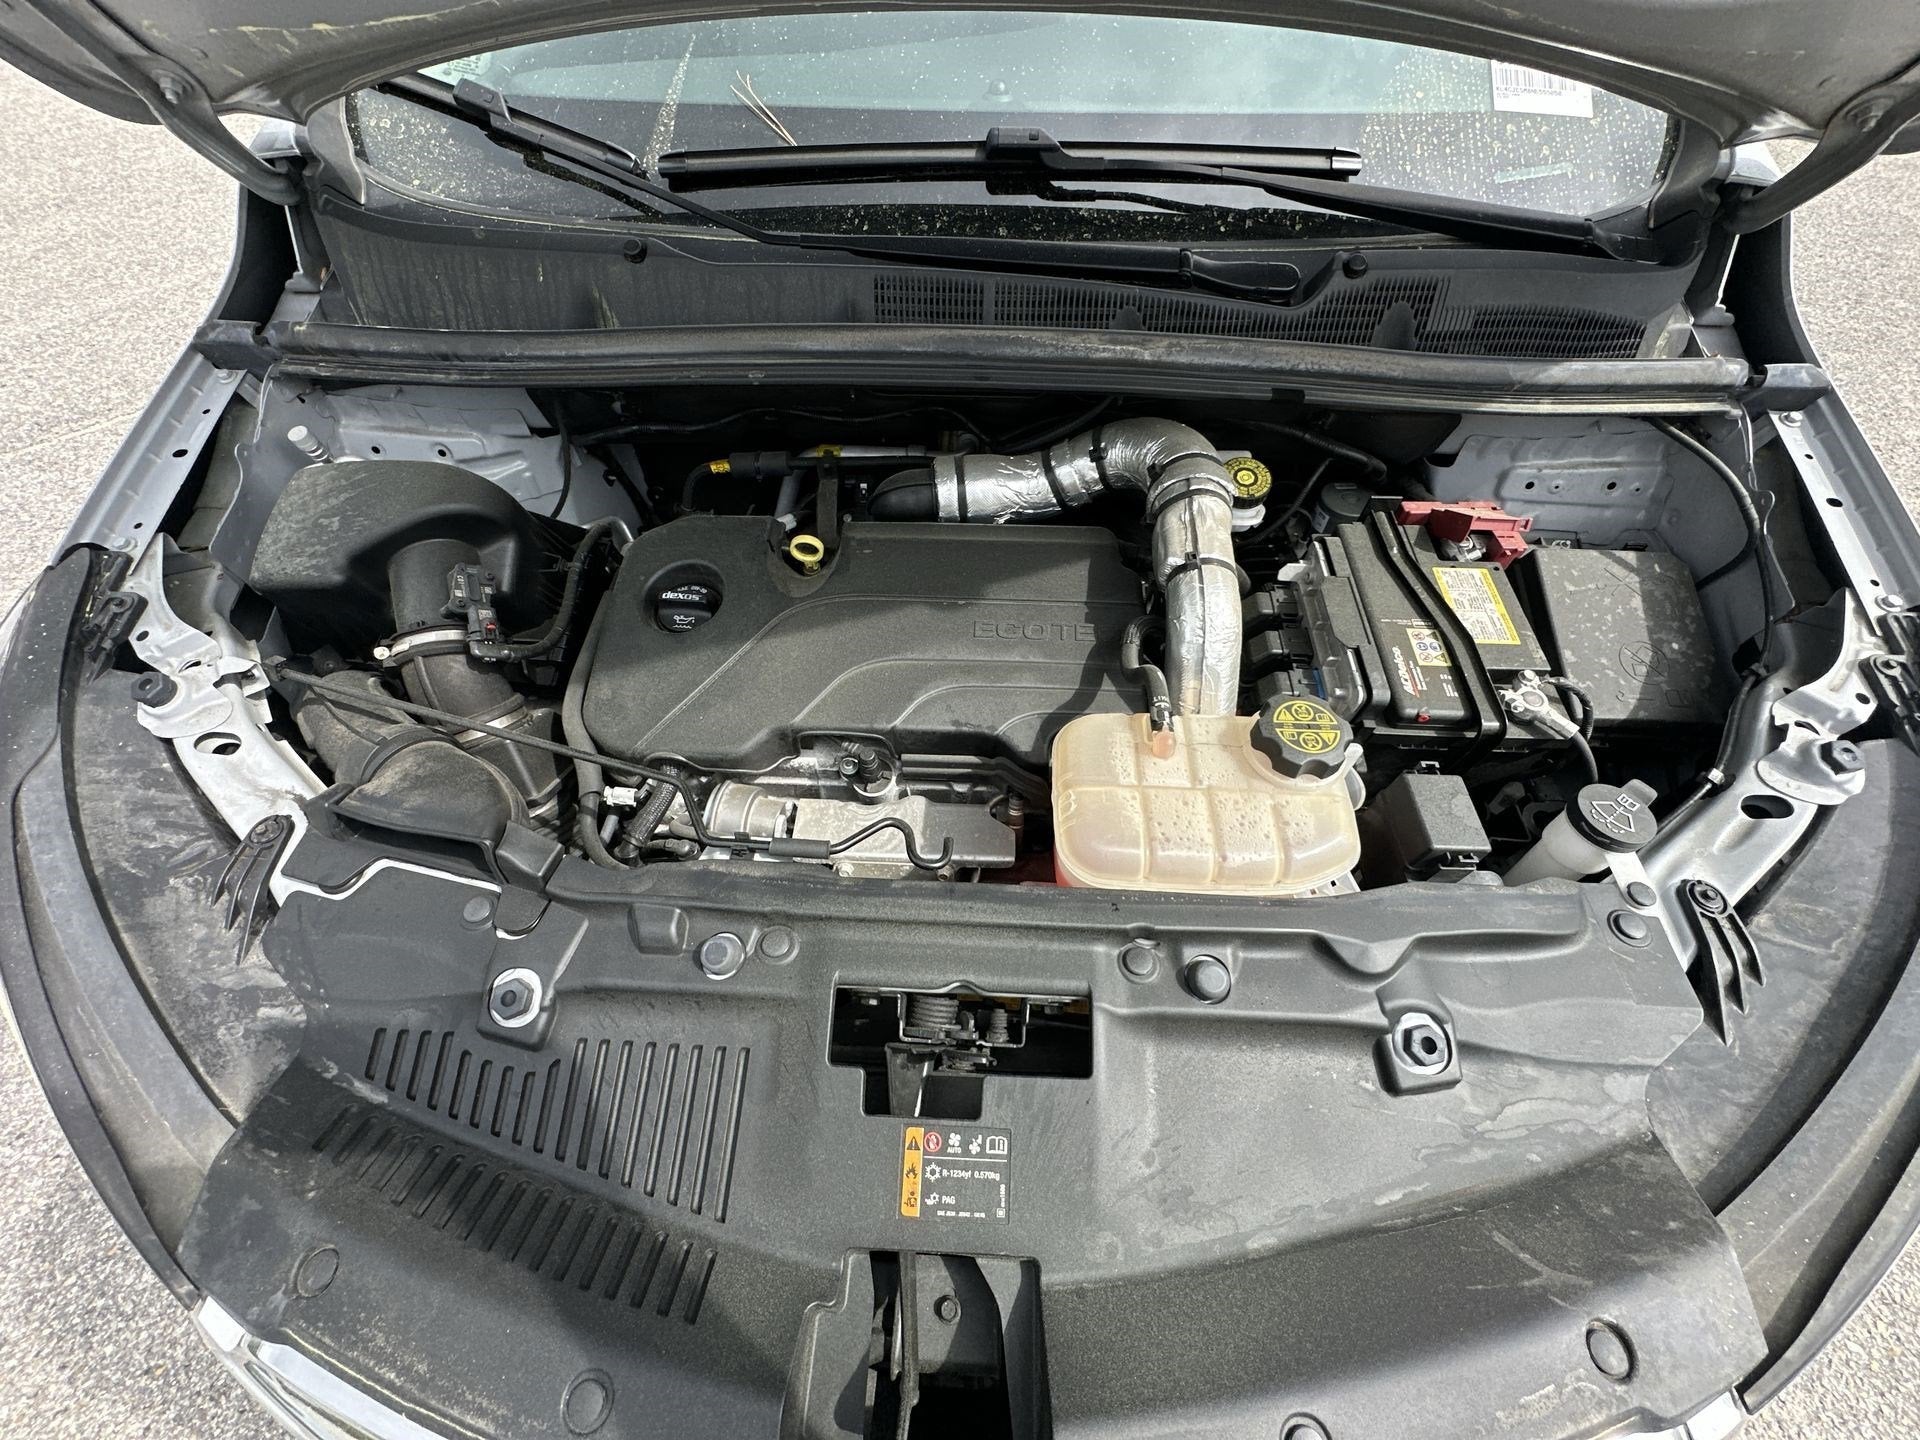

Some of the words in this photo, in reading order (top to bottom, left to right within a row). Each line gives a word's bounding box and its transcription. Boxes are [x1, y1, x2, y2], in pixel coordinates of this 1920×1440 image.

[661, 590, 701, 601] dexos
[972, 620, 1098, 642] ECOTE
[1391, 646, 1416, 696] ACDelco
[942, 1168, 972, 1180] R-1234yf
[973, 1170, 1000, 1181] 0.570kg
[941, 1195, 956, 1204] PAG
